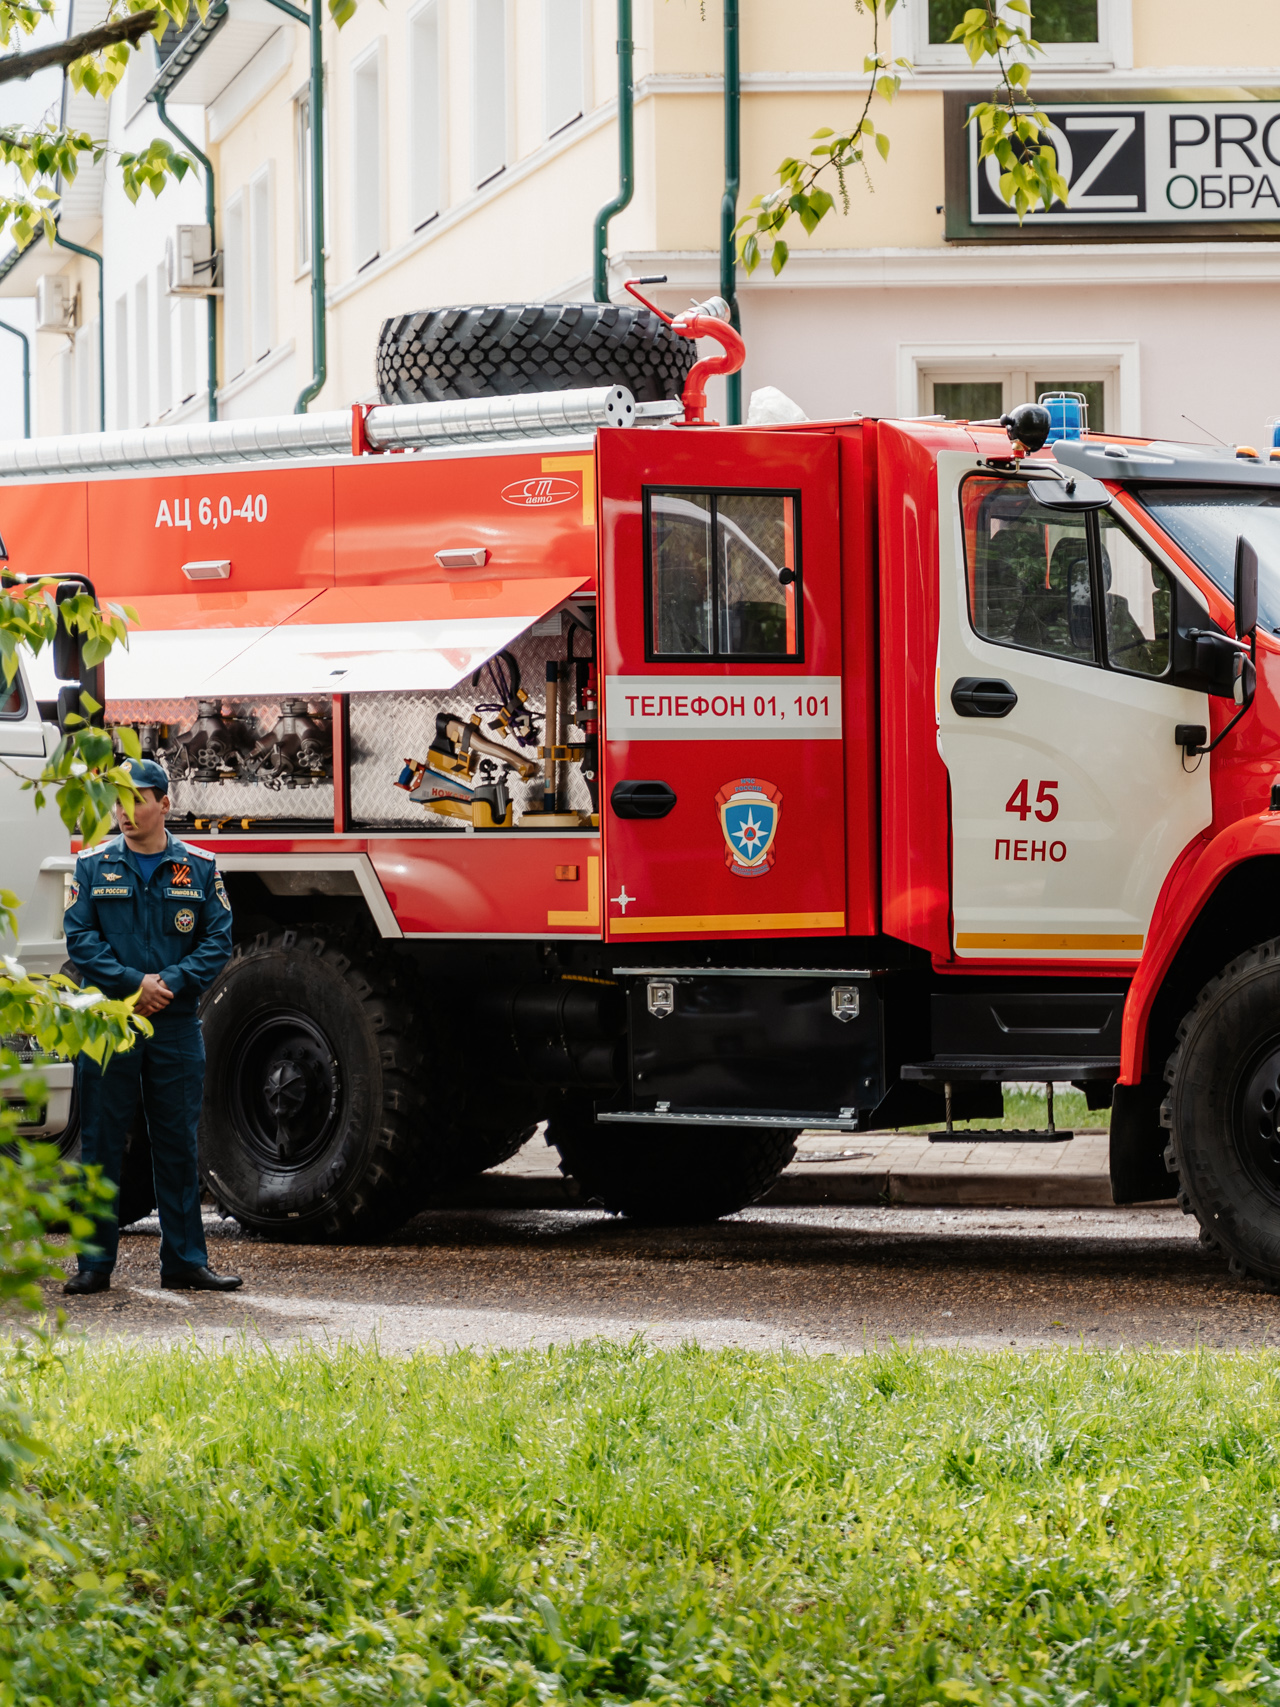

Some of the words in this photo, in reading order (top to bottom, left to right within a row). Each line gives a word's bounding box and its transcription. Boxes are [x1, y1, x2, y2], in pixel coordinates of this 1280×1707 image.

[155, 498, 191, 531] АЦ
[198, 494, 267, 530] 6,0-40
[625, 696, 745, 716] ТЕЛЕФОН
[753, 696, 785, 720] 01,
[794, 696, 829, 716] 101
[1005, 779, 1059, 822] 45
[995, 839, 1067, 862] ПЕНО
